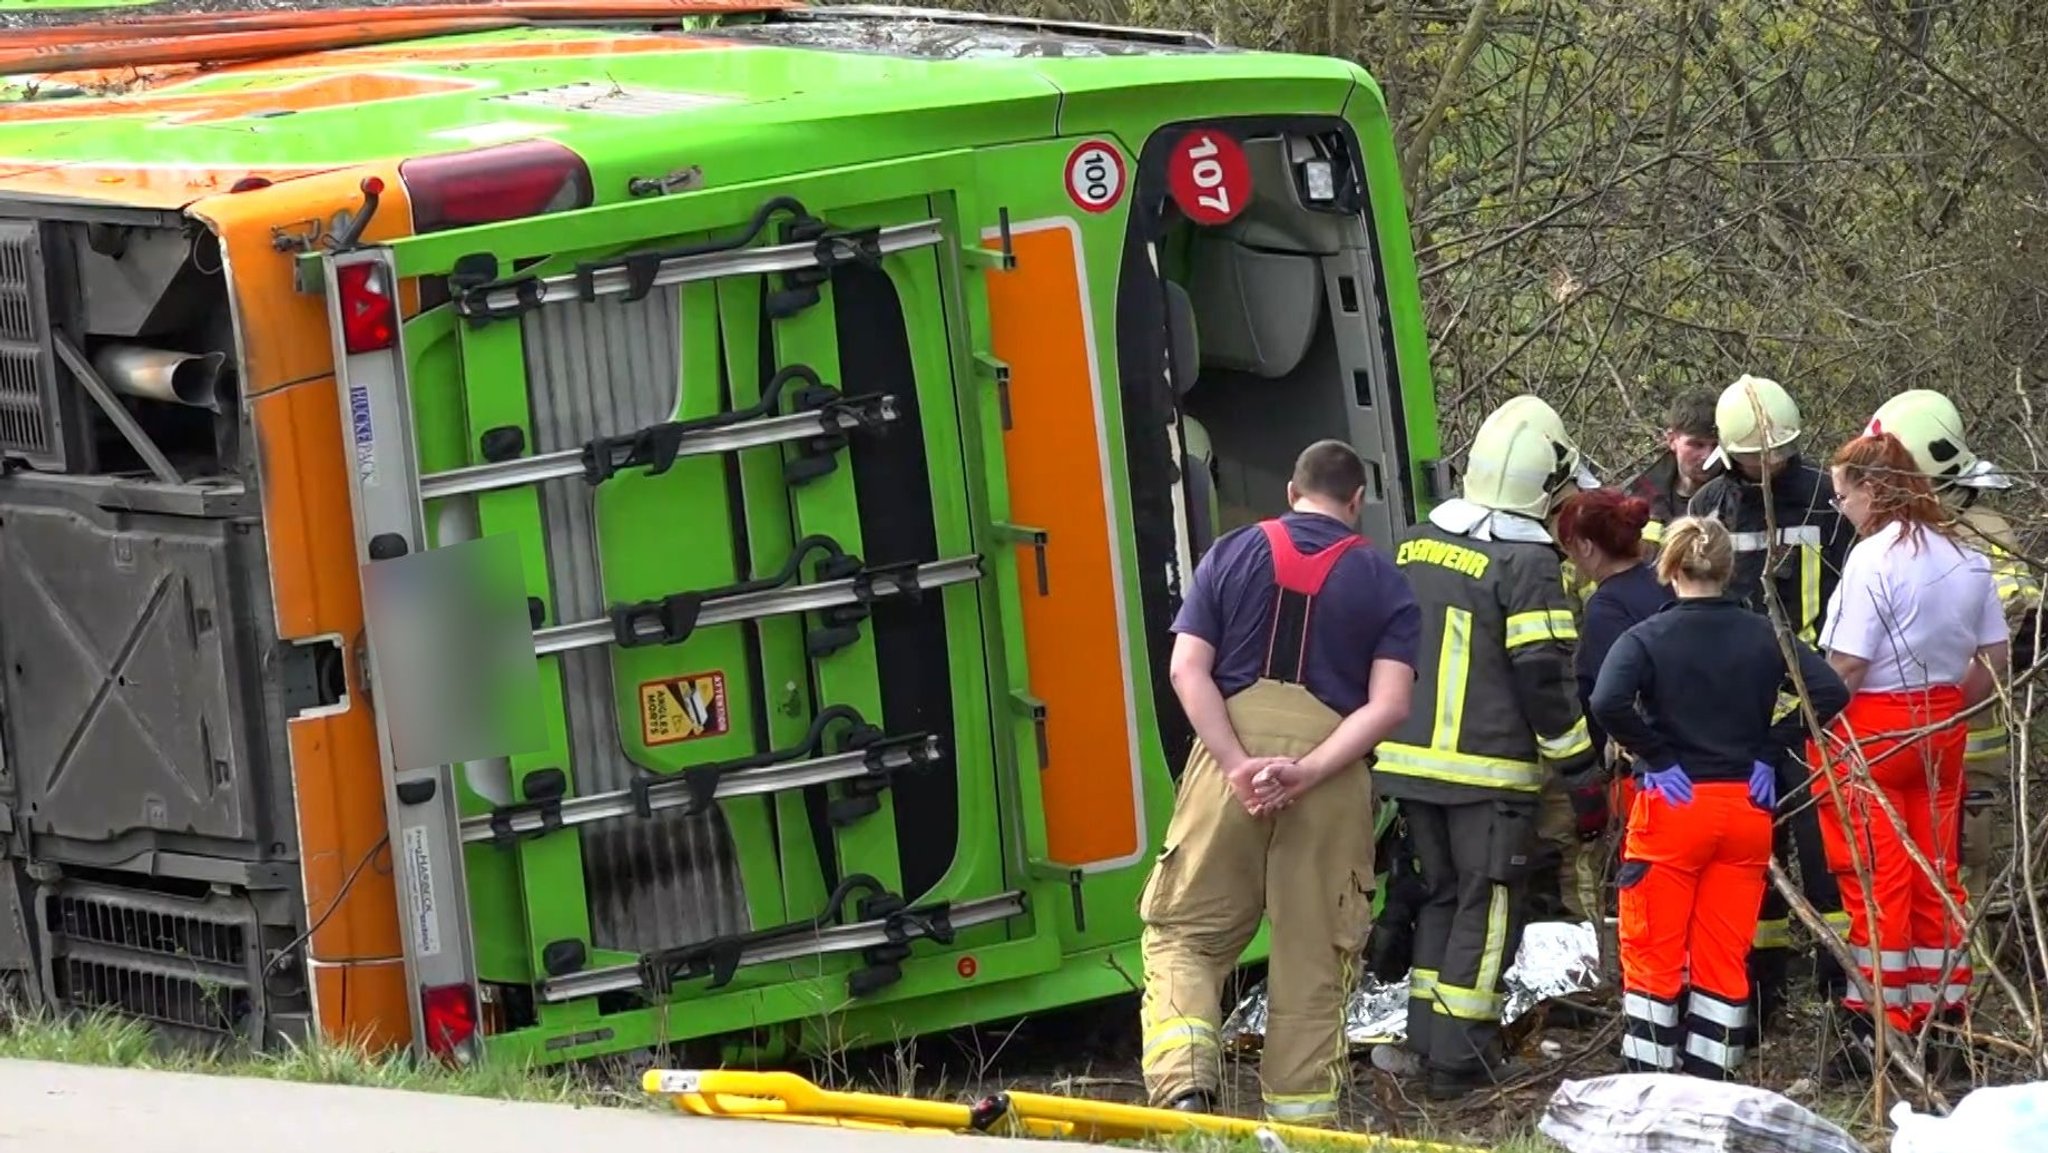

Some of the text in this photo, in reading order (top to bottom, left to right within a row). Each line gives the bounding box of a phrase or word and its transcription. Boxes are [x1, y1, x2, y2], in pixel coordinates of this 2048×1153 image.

[1084, 152, 1108, 201] 100
[1188, 136, 1231, 214] 107
[1395, 538, 1490, 580] EUERWEHR
[648, 694, 659, 734] MORTS
[657, 690, 669, 735] ANGLES
